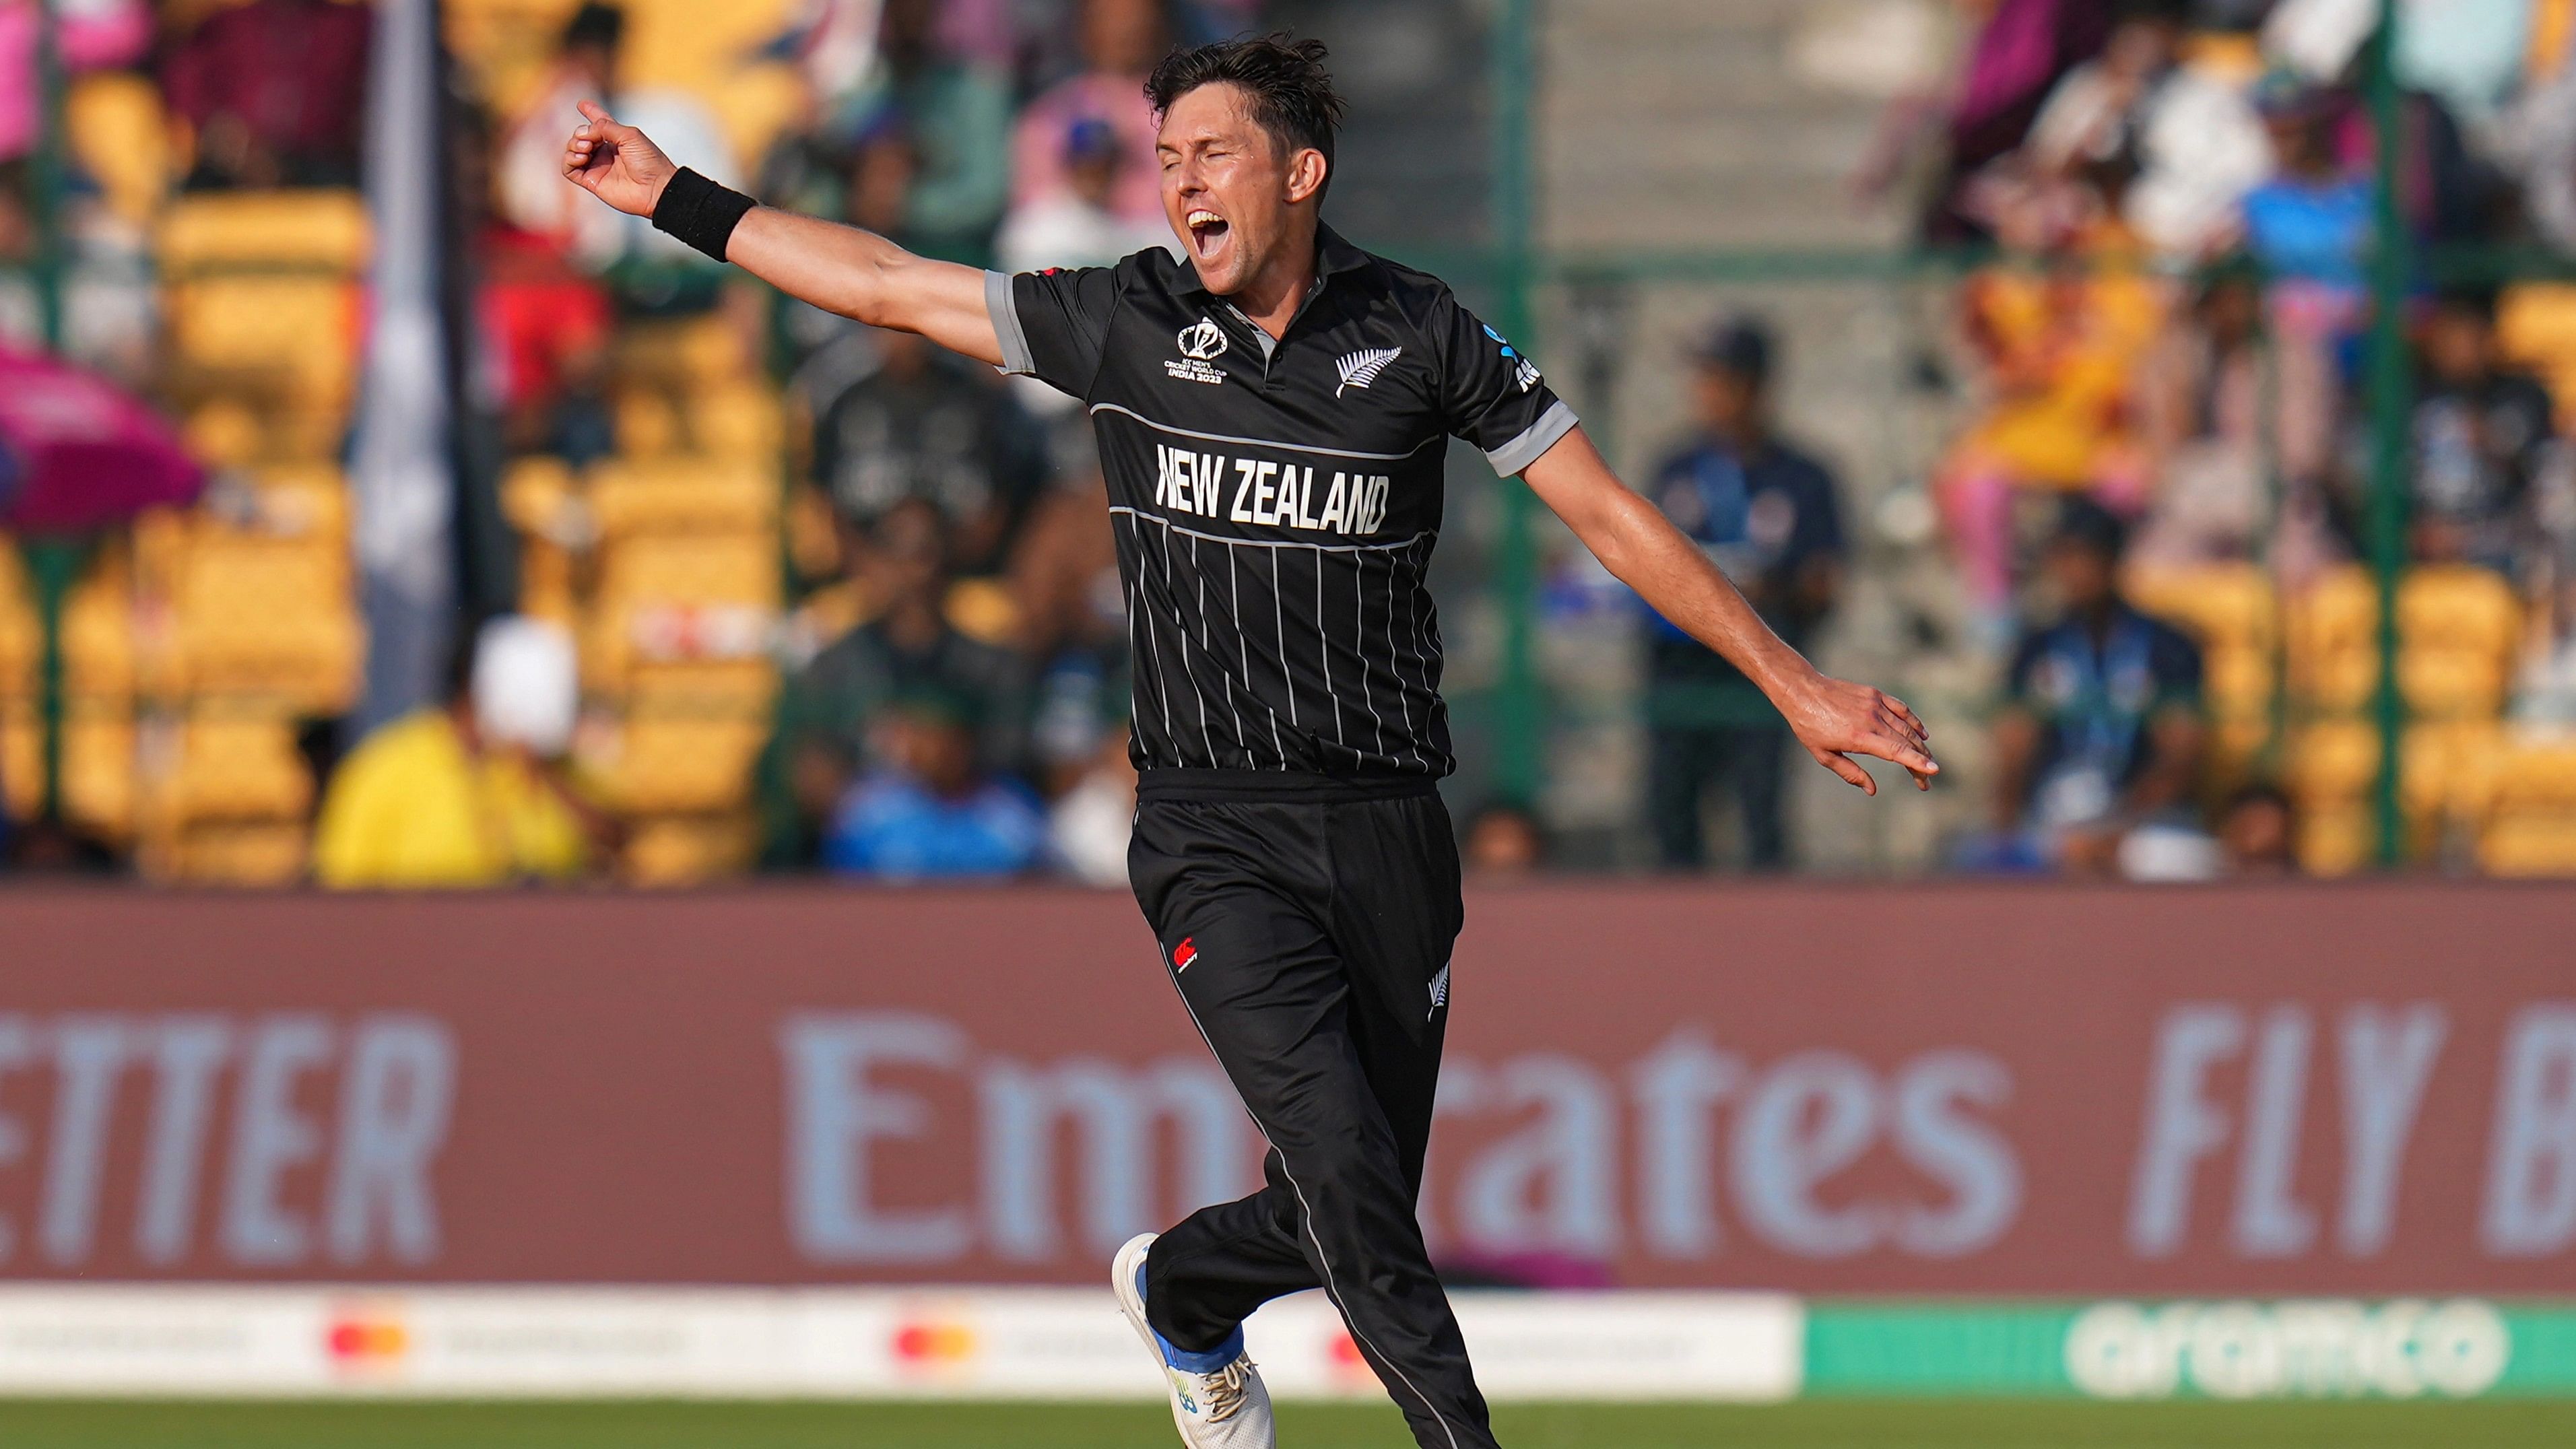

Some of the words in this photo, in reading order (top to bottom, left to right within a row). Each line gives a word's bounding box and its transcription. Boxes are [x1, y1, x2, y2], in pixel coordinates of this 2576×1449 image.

[1164, 360, 1191, 370] CRICKET
[1191, 366, 1214, 374] WORLD
[1214, 369, 1228, 377] CUP
[1168, 368, 1195, 380] INDIA
[1196, 373, 1222, 384] 2023
[1156, 444, 1225, 518] NEW
[1230, 459, 1389, 535] ZEALAND
[780, 1011, 2022, 1262] Emates
[2125, 1001, 2447, 1258] FLY
[2062, 1296, 2513, 1399] aramco
